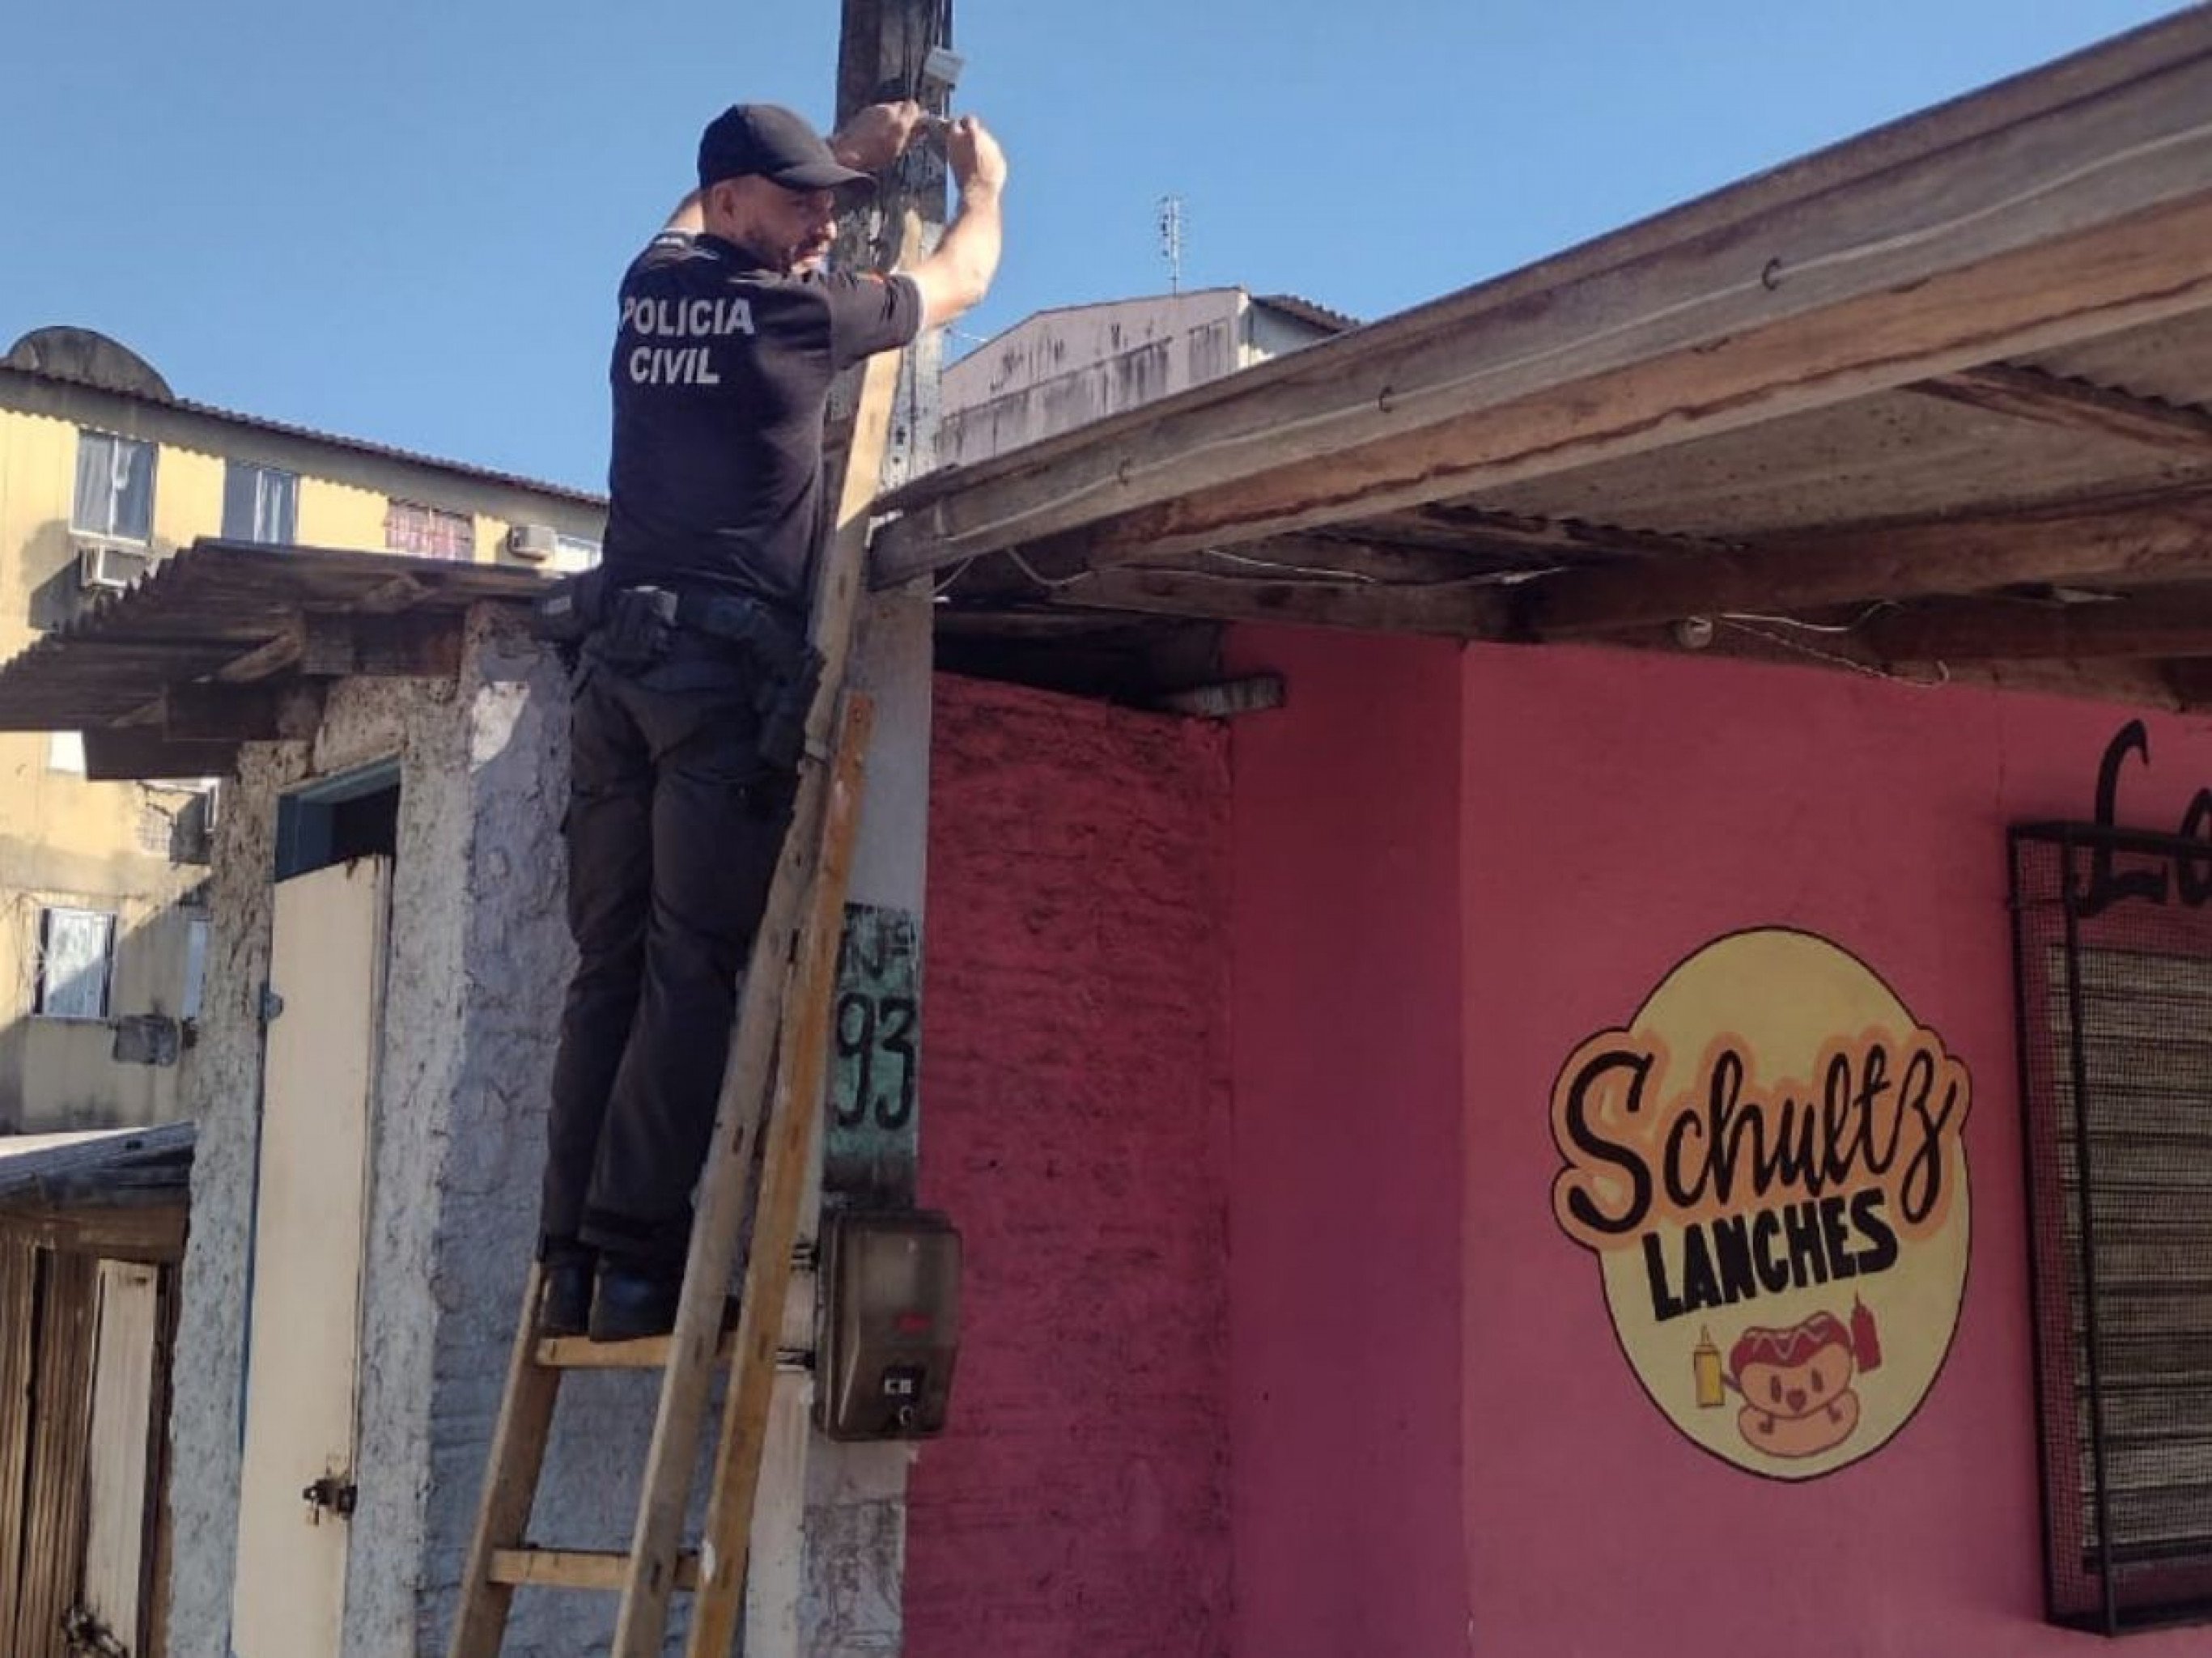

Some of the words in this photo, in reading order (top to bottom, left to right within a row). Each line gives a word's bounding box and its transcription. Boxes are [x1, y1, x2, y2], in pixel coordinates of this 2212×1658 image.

[621, 296, 755, 336] POLICIA
[630, 346, 720, 384] CIVIL
[837, 992, 916, 1130] 93
[1566, 1044, 1957, 1231] Schultz
[1641, 1188, 1898, 1321] LANCHES
